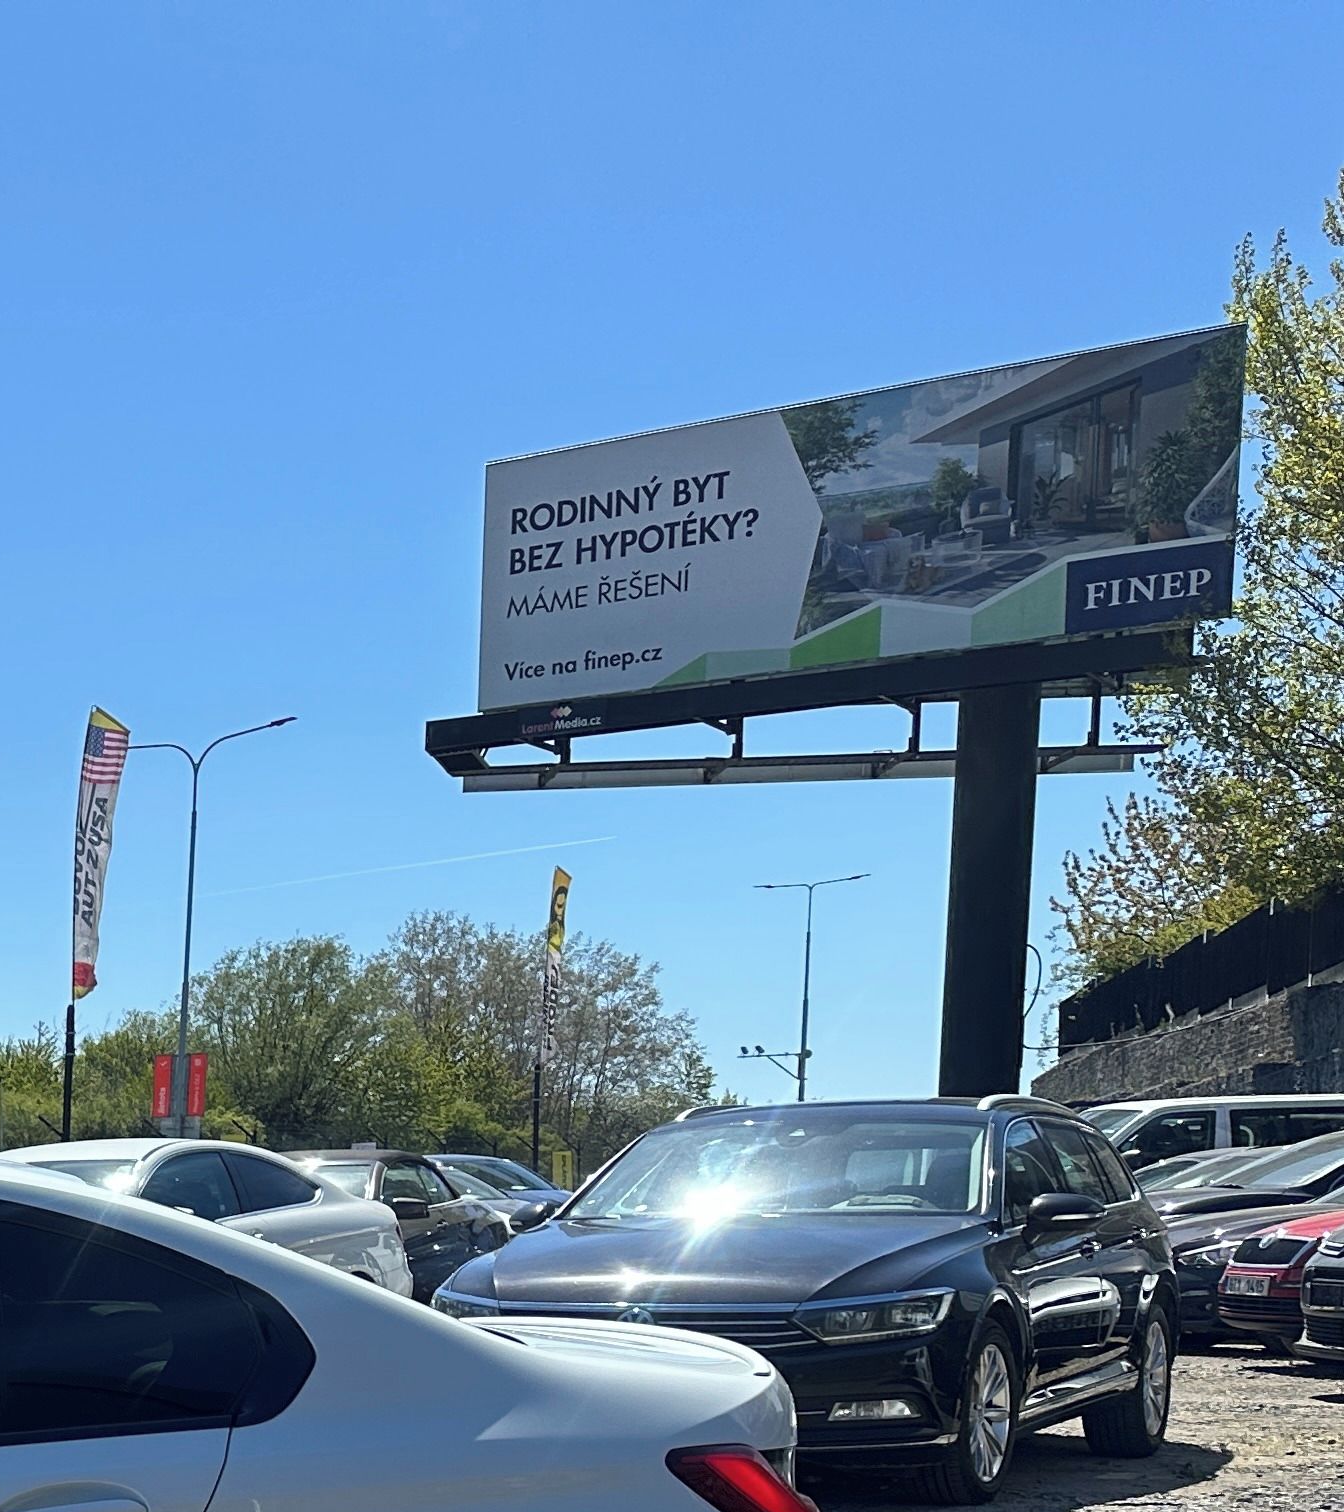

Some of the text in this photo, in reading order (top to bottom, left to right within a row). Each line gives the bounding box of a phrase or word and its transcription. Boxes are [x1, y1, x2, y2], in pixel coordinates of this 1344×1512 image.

[511, 470, 731, 535] RODINNÝ BYT
[509, 508, 760, 576] BEZ HYPOTÉKY?
[506, 562, 692, 619] MÁME ŘEŠENÍ
[1083, 567, 1213, 611] FINEP
[504, 647, 663, 681] Více na finep.cz
[81, 797, 109, 929] AUT Z USA
